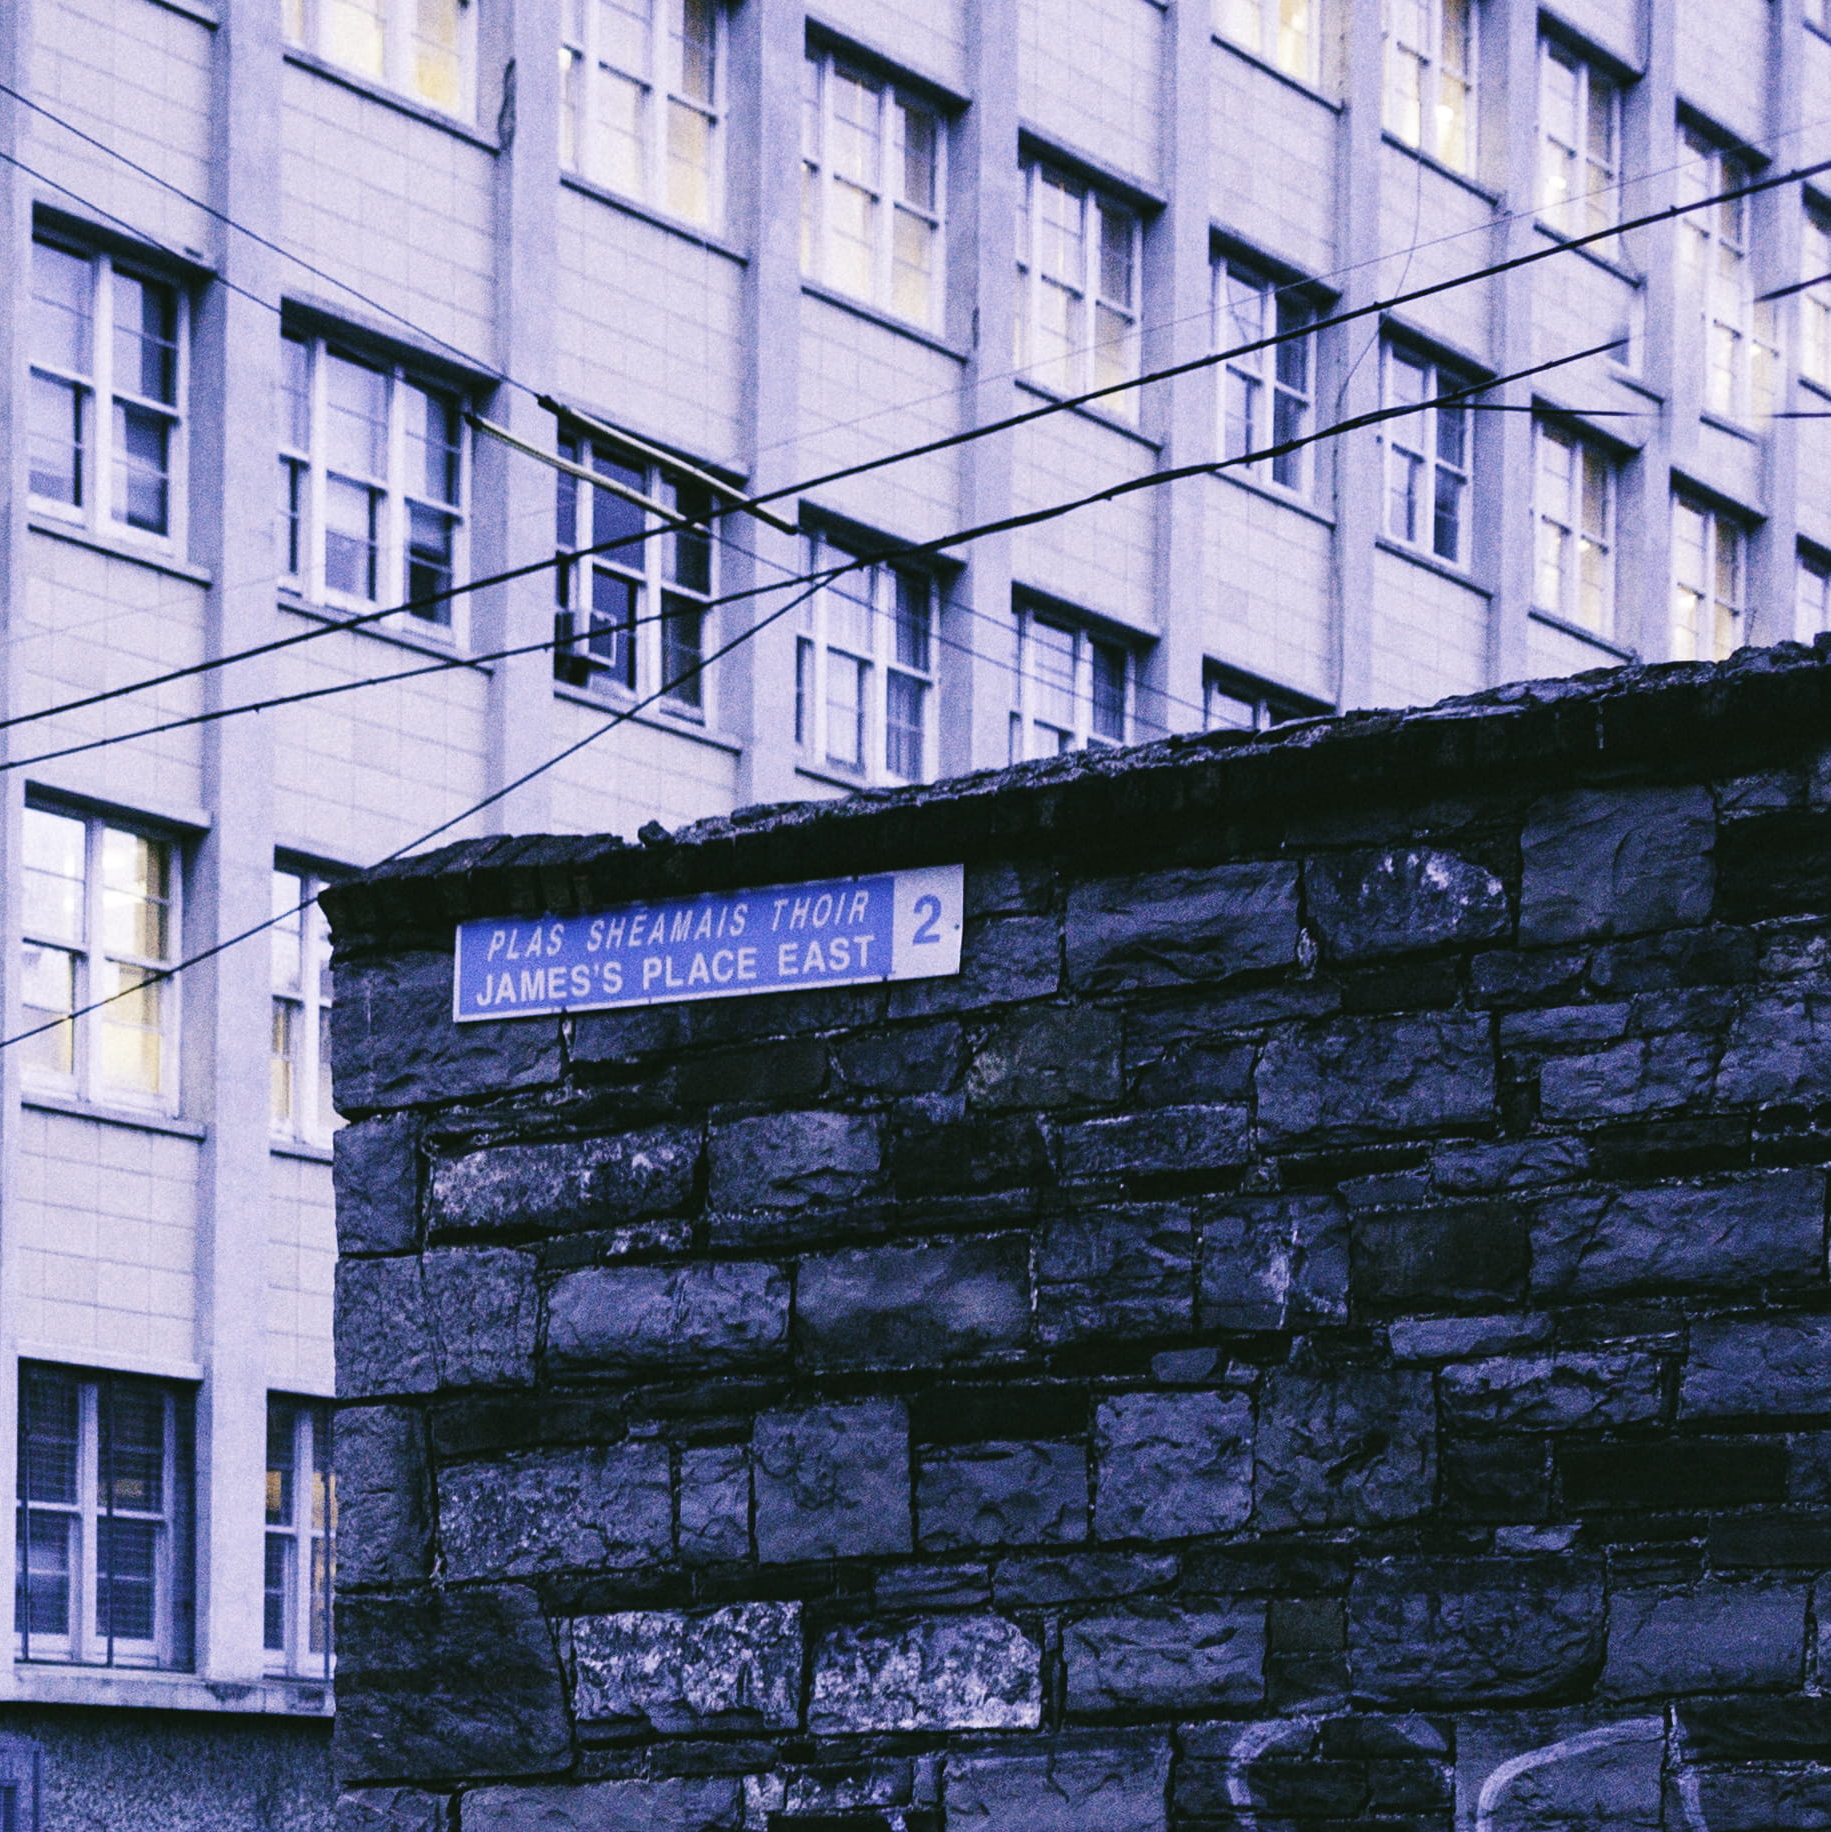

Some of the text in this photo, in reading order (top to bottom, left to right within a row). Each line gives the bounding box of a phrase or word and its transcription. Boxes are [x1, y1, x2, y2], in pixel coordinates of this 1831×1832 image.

[772, 890, 869, 932] THOIR
[912, 894, 943, 944] 2
[476, 935, 875, 1007] JAMES'S PLACE EAST
